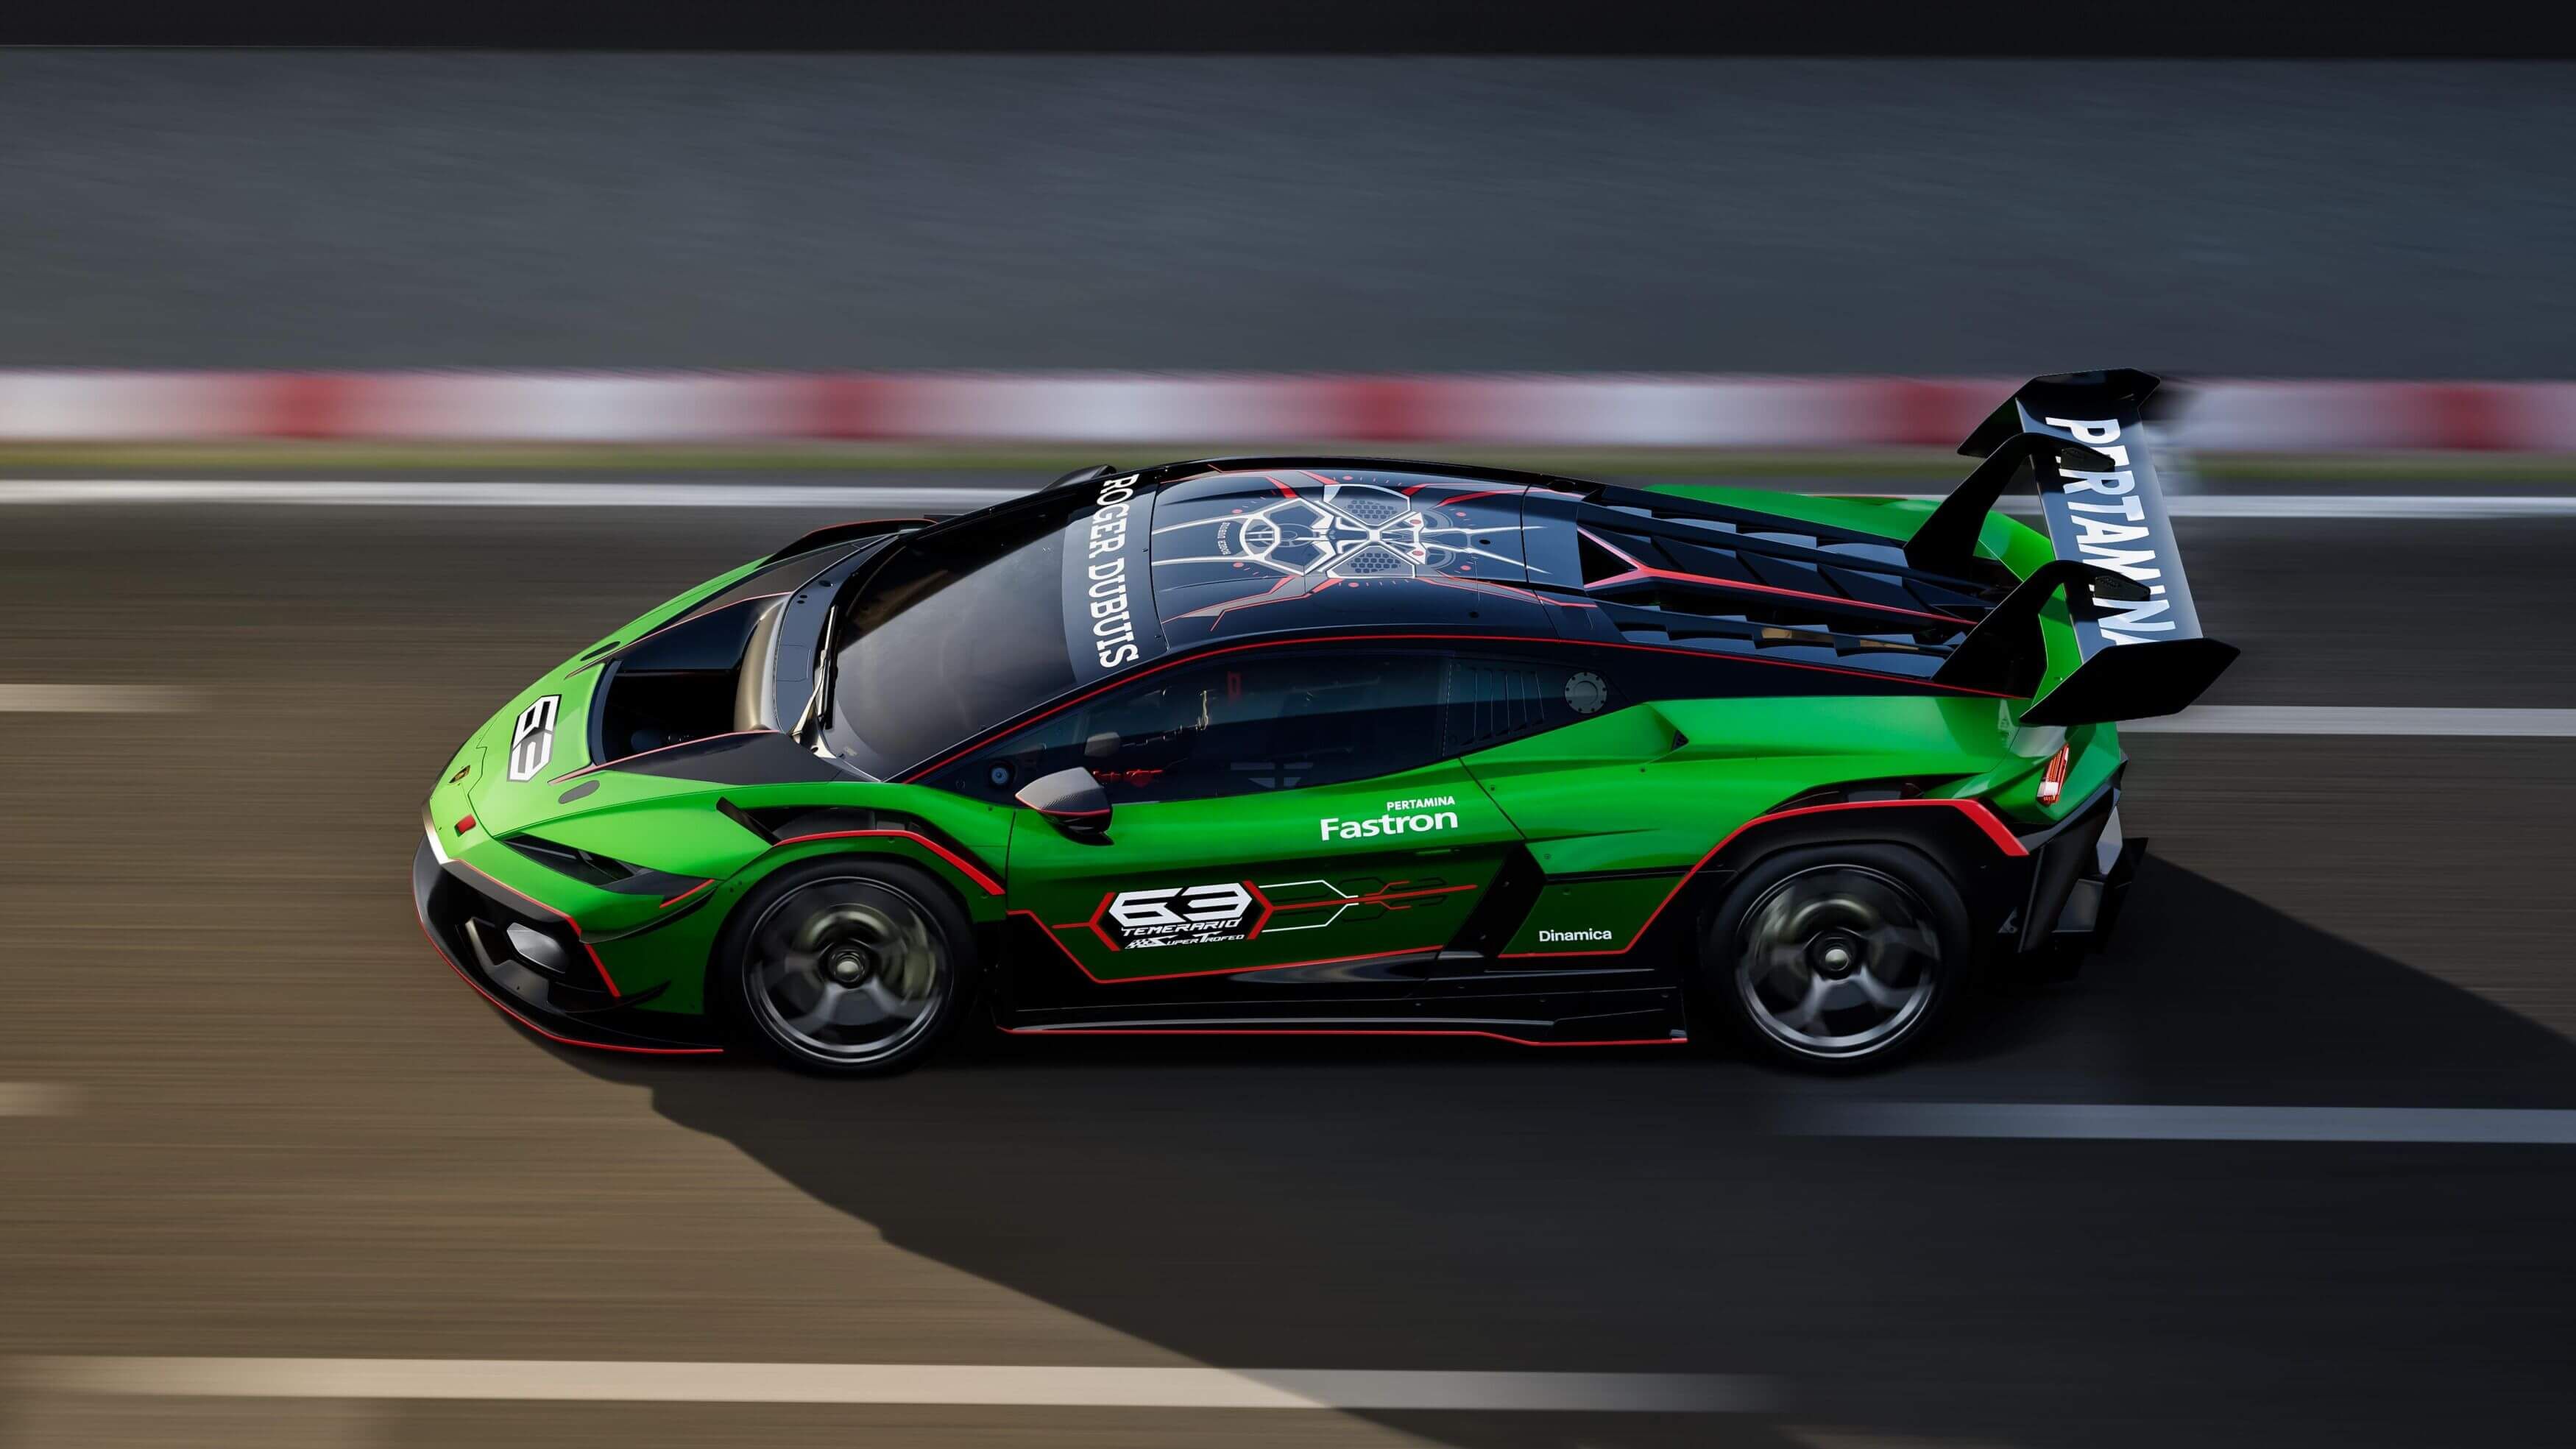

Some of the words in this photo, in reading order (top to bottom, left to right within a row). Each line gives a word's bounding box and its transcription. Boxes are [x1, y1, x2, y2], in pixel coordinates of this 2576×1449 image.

[1089, 473, 1140, 559] ROGER
[1089, 557, 1140, 668] DUBUIS
[509, 695, 560, 782] 63
[1387, 796, 1456, 811] PERTAMINA
[1320, 811, 1459, 841] Fastron
[1108, 882, 1253, 927] 63
[1121, 918, 1243, 937] TEMERARIO
[1538, 927, 1613, 942] Dinamica
